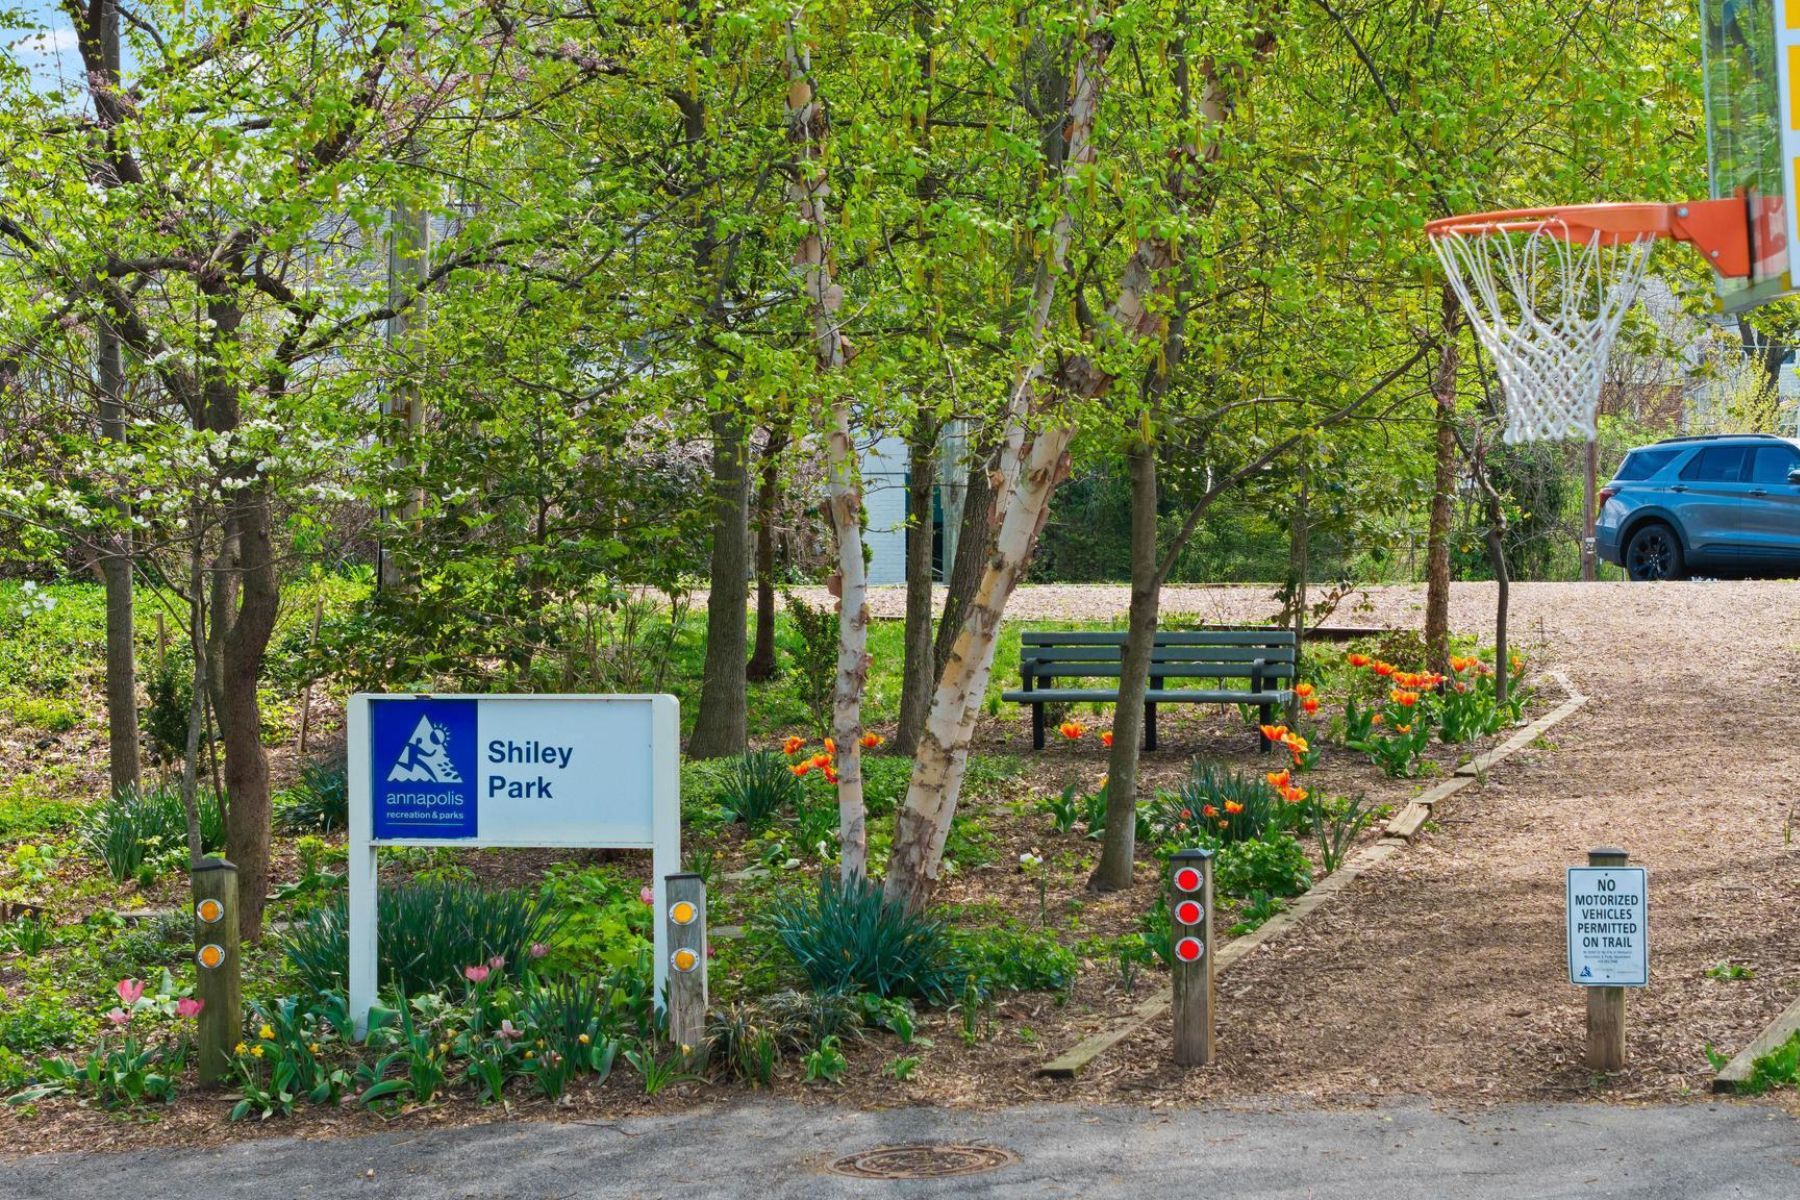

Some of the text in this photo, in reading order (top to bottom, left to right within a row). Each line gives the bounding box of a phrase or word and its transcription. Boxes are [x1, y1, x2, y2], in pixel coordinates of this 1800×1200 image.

[488, 740, 573, 768] Shiley
[488, 776, 553, 798] Park
[386, 790, 464, 808] annapolis
[386, 811, 430, 819] recreation
[439, 811, 464, 820] parks
[1597, 879, 1616, 891] NO
[1575, 895, 1638, 906] MOTORIZED
[1582, 909, 1632, 920] VEHICLES
[1577, 923, 1637, 934] PERMITTED
[1583, 937, 1632, 948] ON TRAIL
